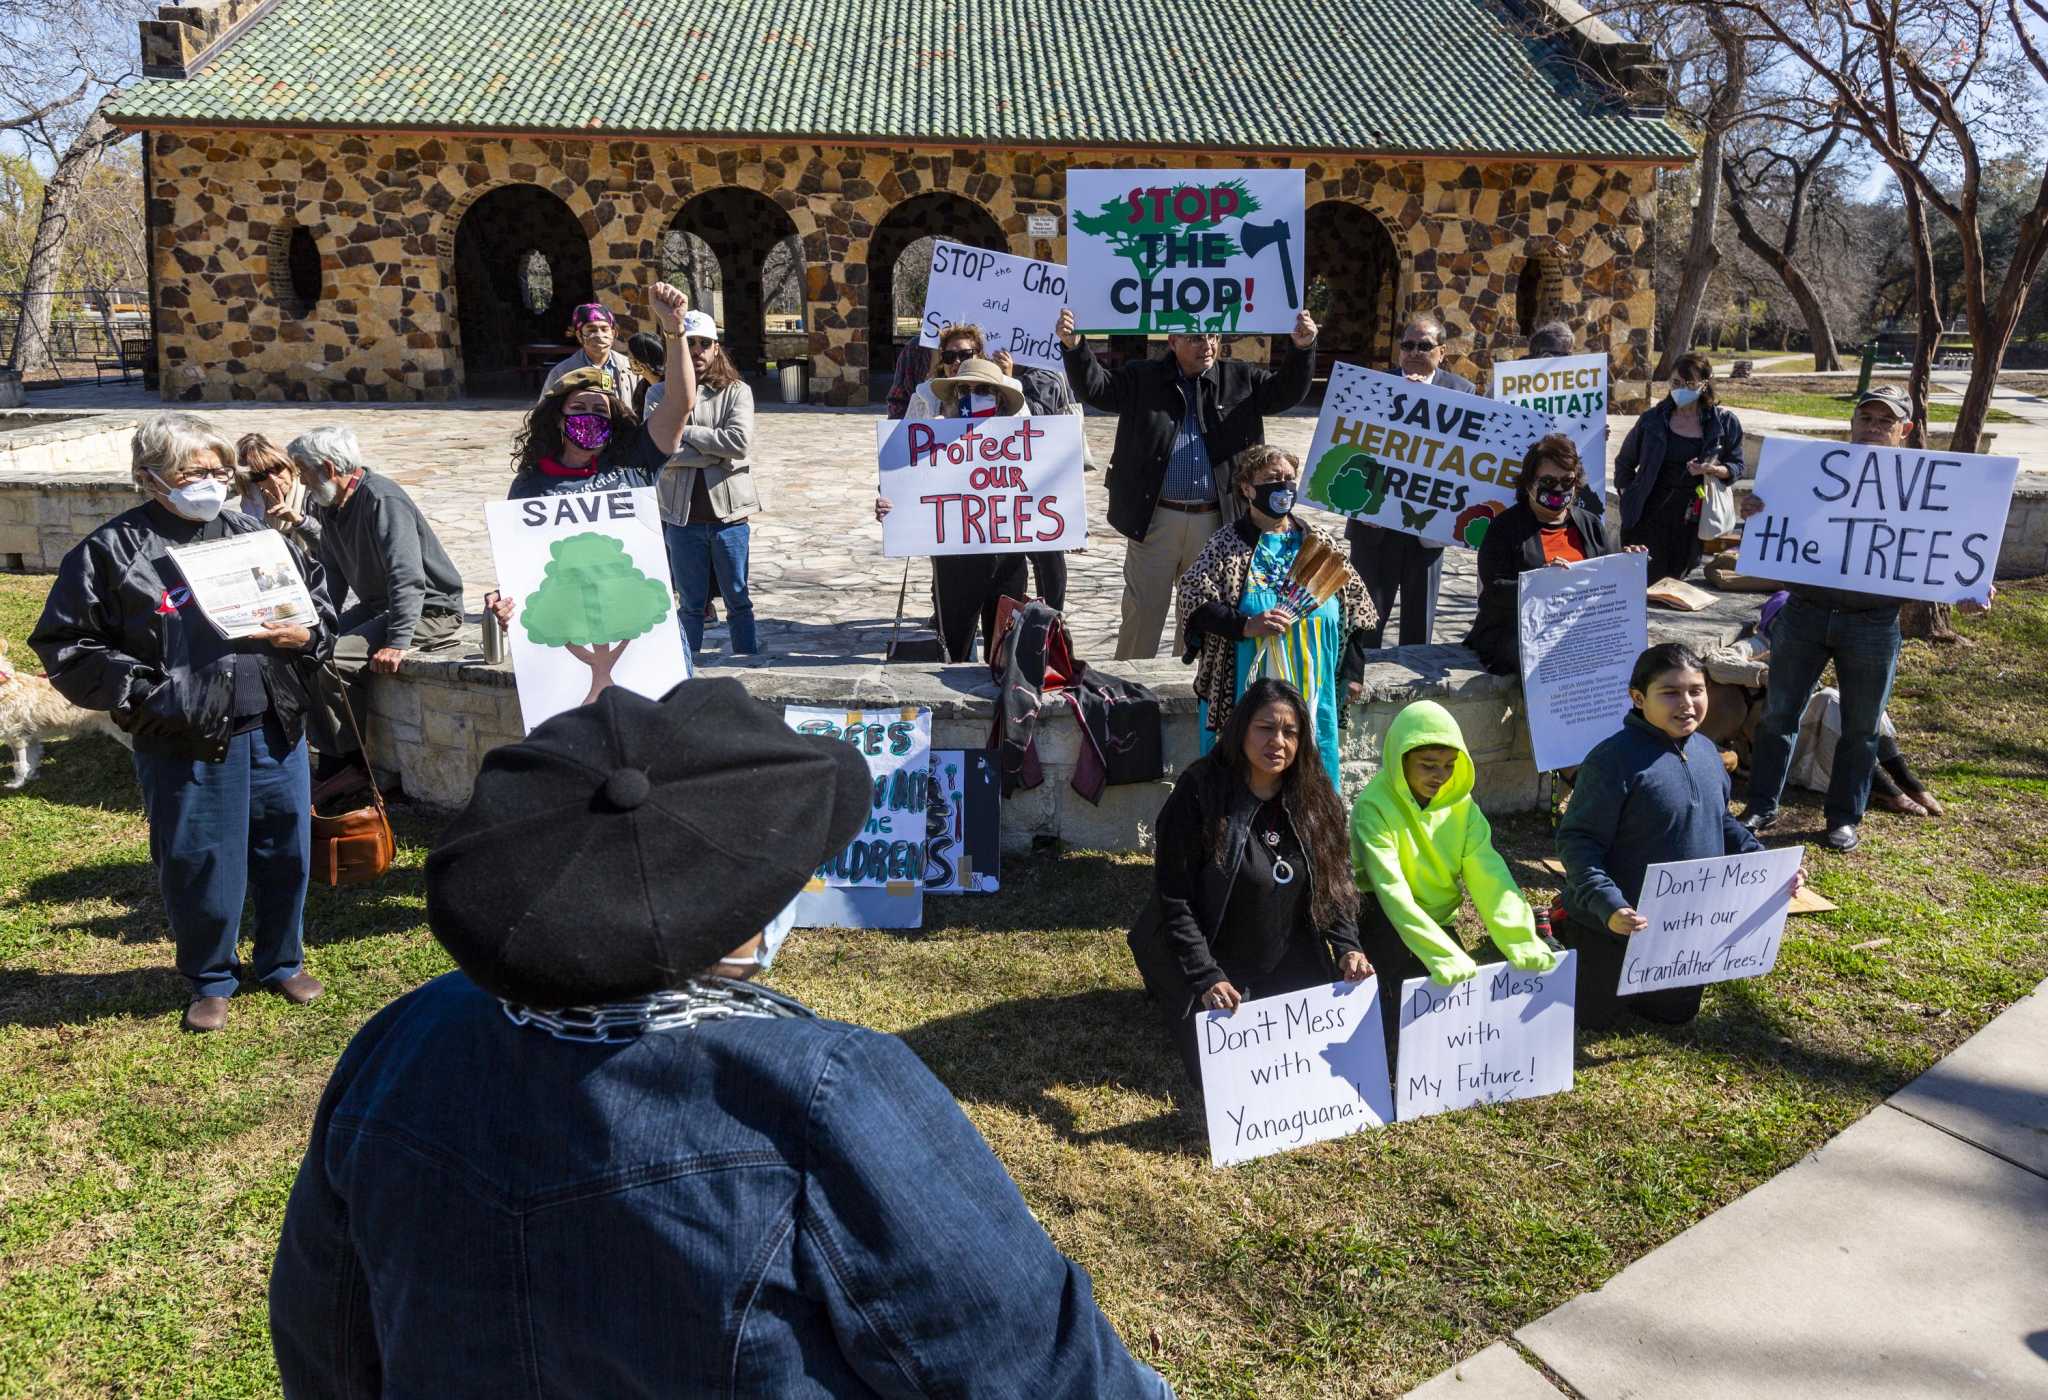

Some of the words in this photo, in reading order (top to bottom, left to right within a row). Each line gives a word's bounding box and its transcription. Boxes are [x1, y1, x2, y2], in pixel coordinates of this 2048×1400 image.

[1128, 186, 1240, 224] STOP
[934, 246, 995, 281] STOP
[995, 266, 1012, 277] the
[1138, 233, 1228, 268] THE
[982, 297, 1010, 313] and
[1110, 277, 1255, 314] CHOP!
[985, 331, 1002, 342] the
[1009, 327, 1063, 361] Birds
[1502, 368, 1602, 396] PROTECT
[1388, 393, 1486, 442] SAVE
[1510, 391, 1604, 414] BITATS
[908, 419, 1045, 467] Protect
[1331, 415, 1523, 489] HERITAGE
[1364, 461, 1470, 513] TREES
[1812, 449, 1962, 511] SAVE
[522, 491, 636, 527] SAVE
[920, 493, 1065, 544] TREES
[1755, 515, 1821, 564] the
[1828, 517, 1989, 587] TREES
[863, 814, 893, 835] he
[815, 840, 926, 884] LDREN
[1656, 867, 1716, 898] Don't
[1722, 863, 1768, 888] Mess
[1663, 911, 1703, 932] with
[1710, 910, 1739, 925] our
[1722, 937, 1771, 972] Trees!
[1413, 981, 1478, 1019] Don't
[1491, 972, 1544, 1002] Mess
[1206, 1010, 1278, 1055] Don't
[1285, 998, 1345, 1040] Mess
[1447, 1021, 1500, 1049] with
[1251, 1051, 1311, 1085] with
[1409, 1074, 1442, 1100] My
[1458, 1056, 1535, 1091] Future!
[1226, 1083, 1363, 1147] Yanaguana!
